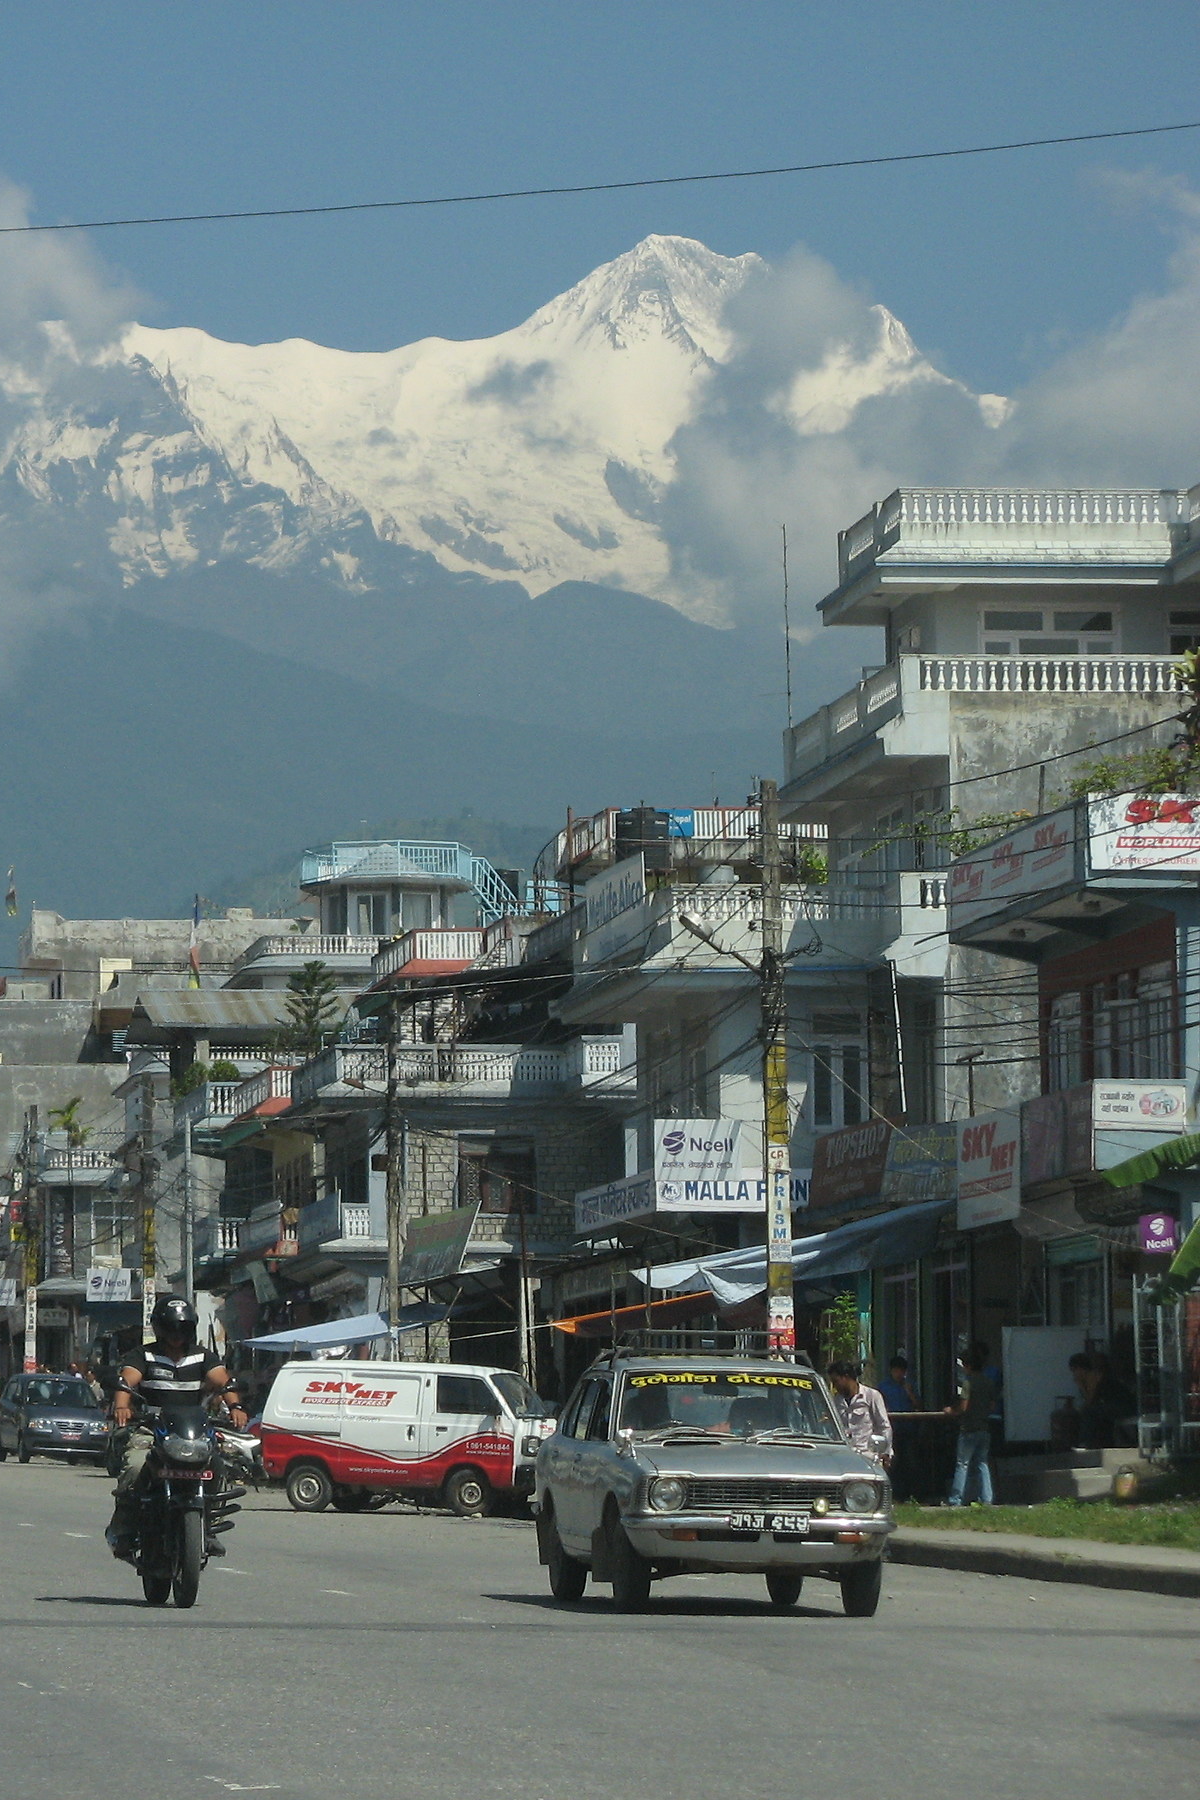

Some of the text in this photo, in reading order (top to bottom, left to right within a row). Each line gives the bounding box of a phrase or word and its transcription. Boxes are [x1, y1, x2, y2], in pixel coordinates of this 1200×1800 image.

[1113, 857, 1198, 865] EXPRESS COURIER
[690, 1138, 734, 1152] Ncell
[961, 1122, 998, 1162] SKY
[990, 1141, 1017, 1172] NET
[685, 1181, 749, 1201] MALLA
[1146, 1237, 1173, 1249] Ncell
[105, 1279, 127, 1287] Ncell
[305, 1381, 398, 1399] SKY NET
